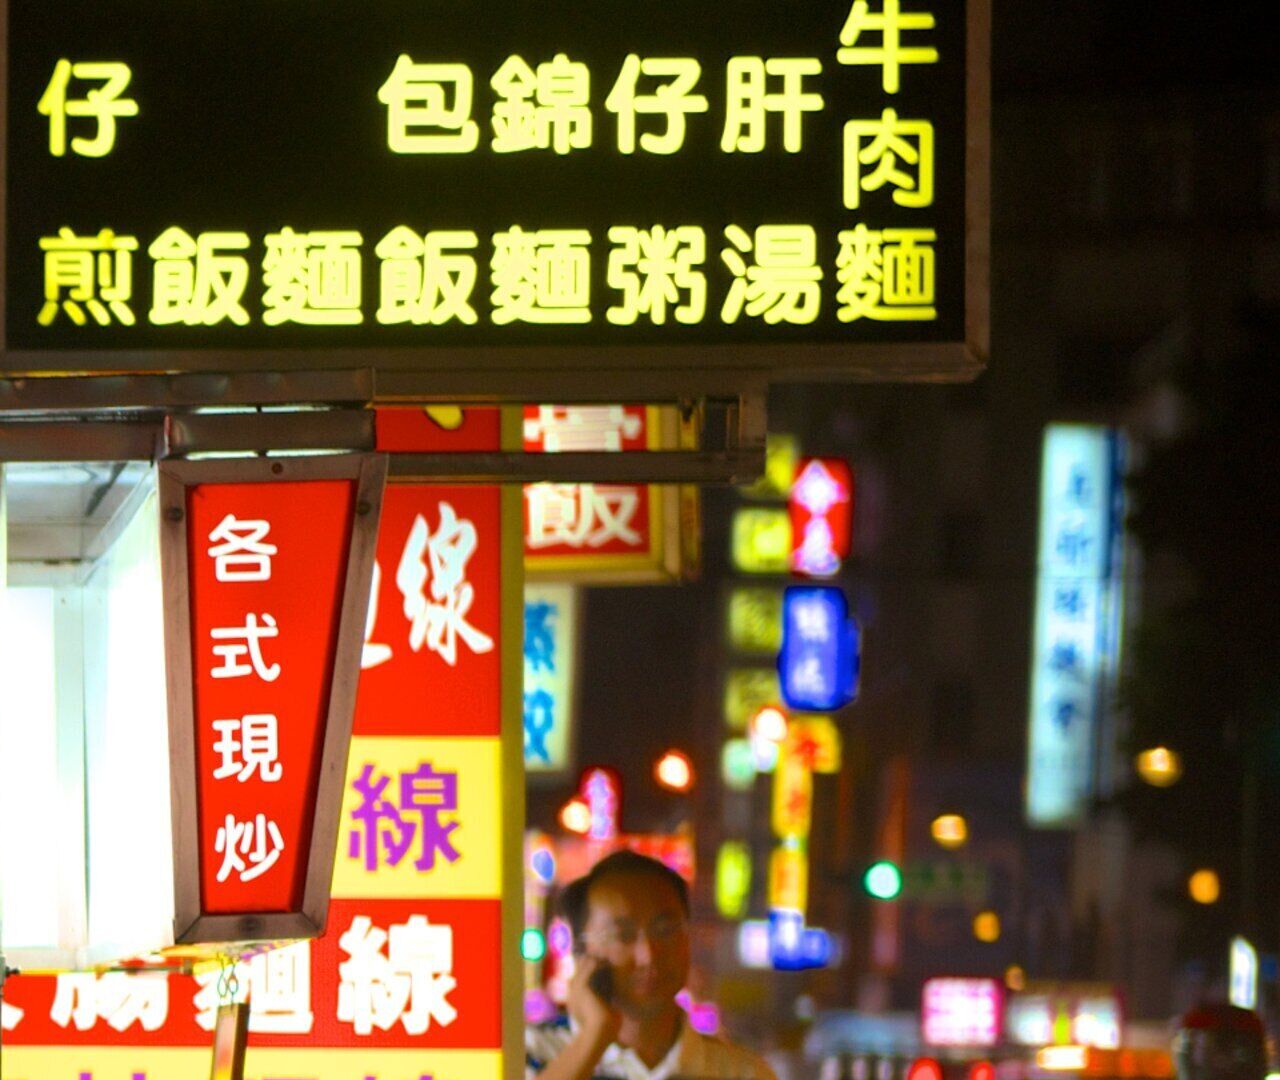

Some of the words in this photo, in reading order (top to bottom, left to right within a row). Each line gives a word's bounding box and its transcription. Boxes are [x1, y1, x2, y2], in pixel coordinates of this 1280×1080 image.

[836, 0, 940, 324] 牛肉麵
[207, 513, 286, 883] 各式現炒
